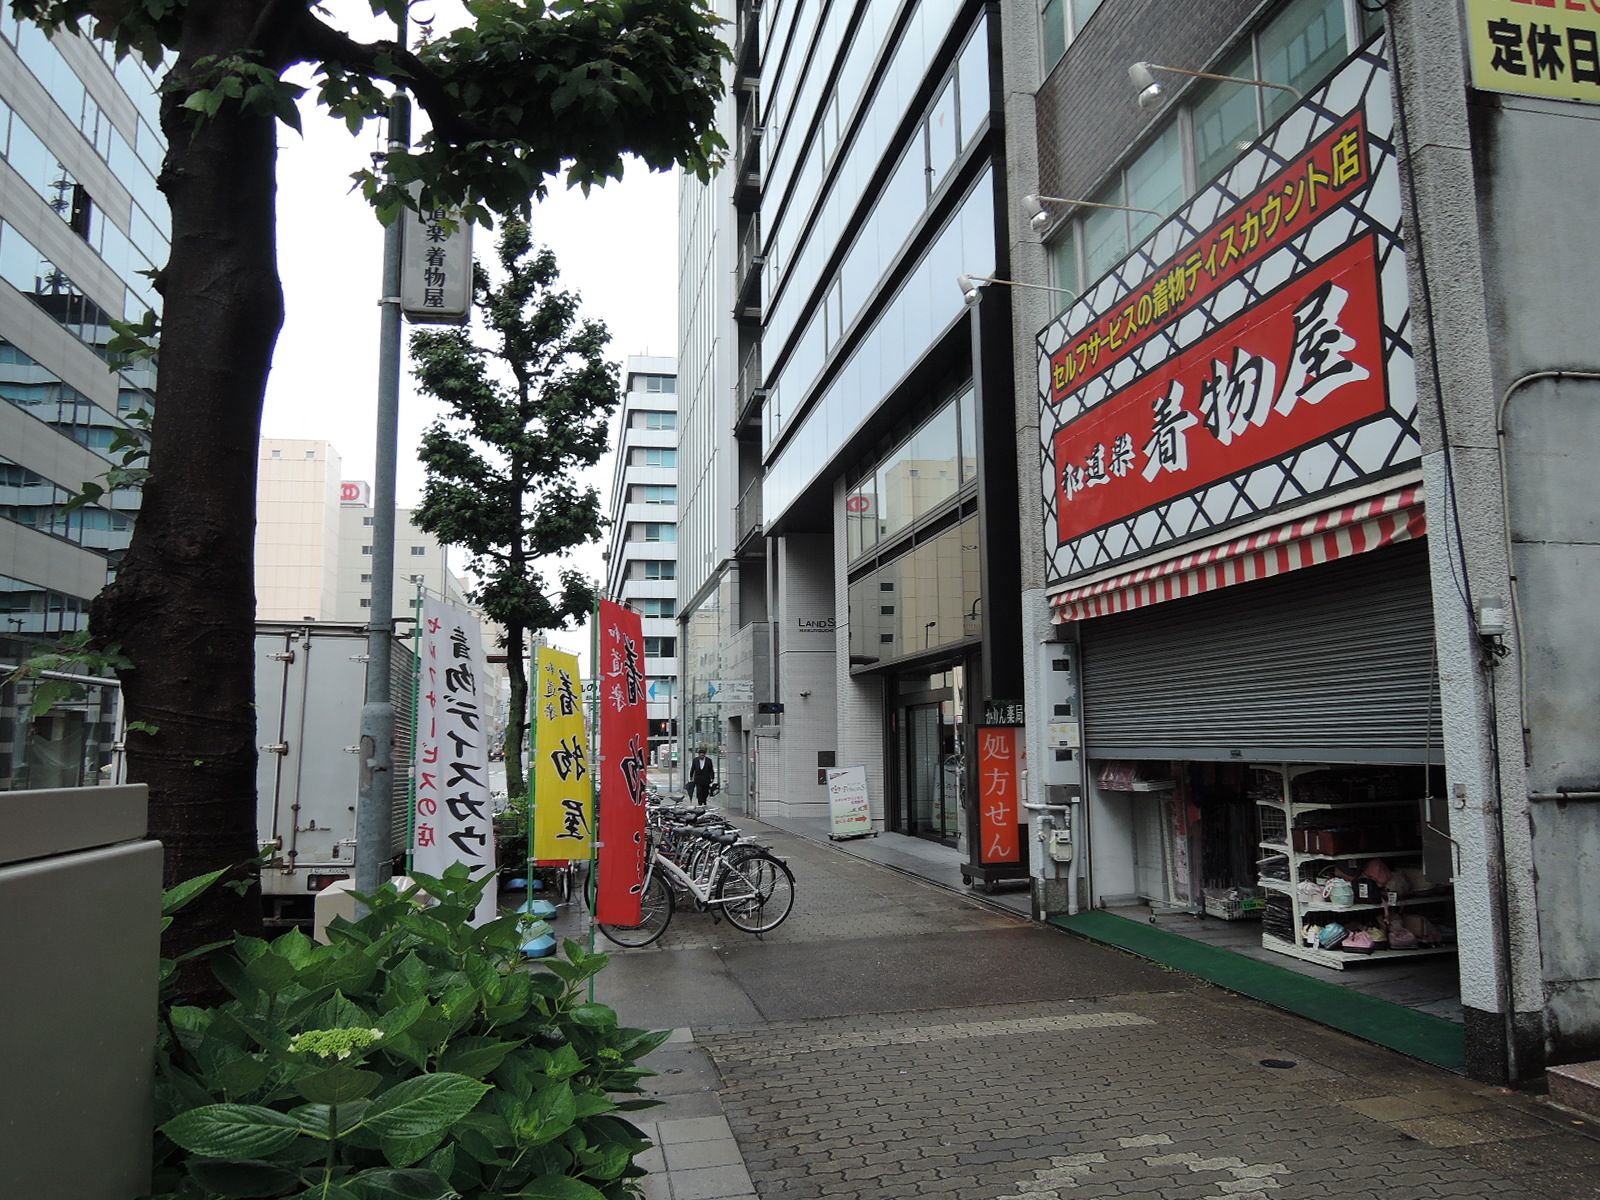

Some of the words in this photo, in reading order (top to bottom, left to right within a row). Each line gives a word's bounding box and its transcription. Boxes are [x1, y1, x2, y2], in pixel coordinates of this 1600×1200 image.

[1487, 18, 1600, 86] 定休日
[1053, 129, 1361, 390] セルフサービスの着物ディスカウント店
[1141, 280, 1370, 483] 着物屋
[983, 733, 1011, 859] 処方せん
